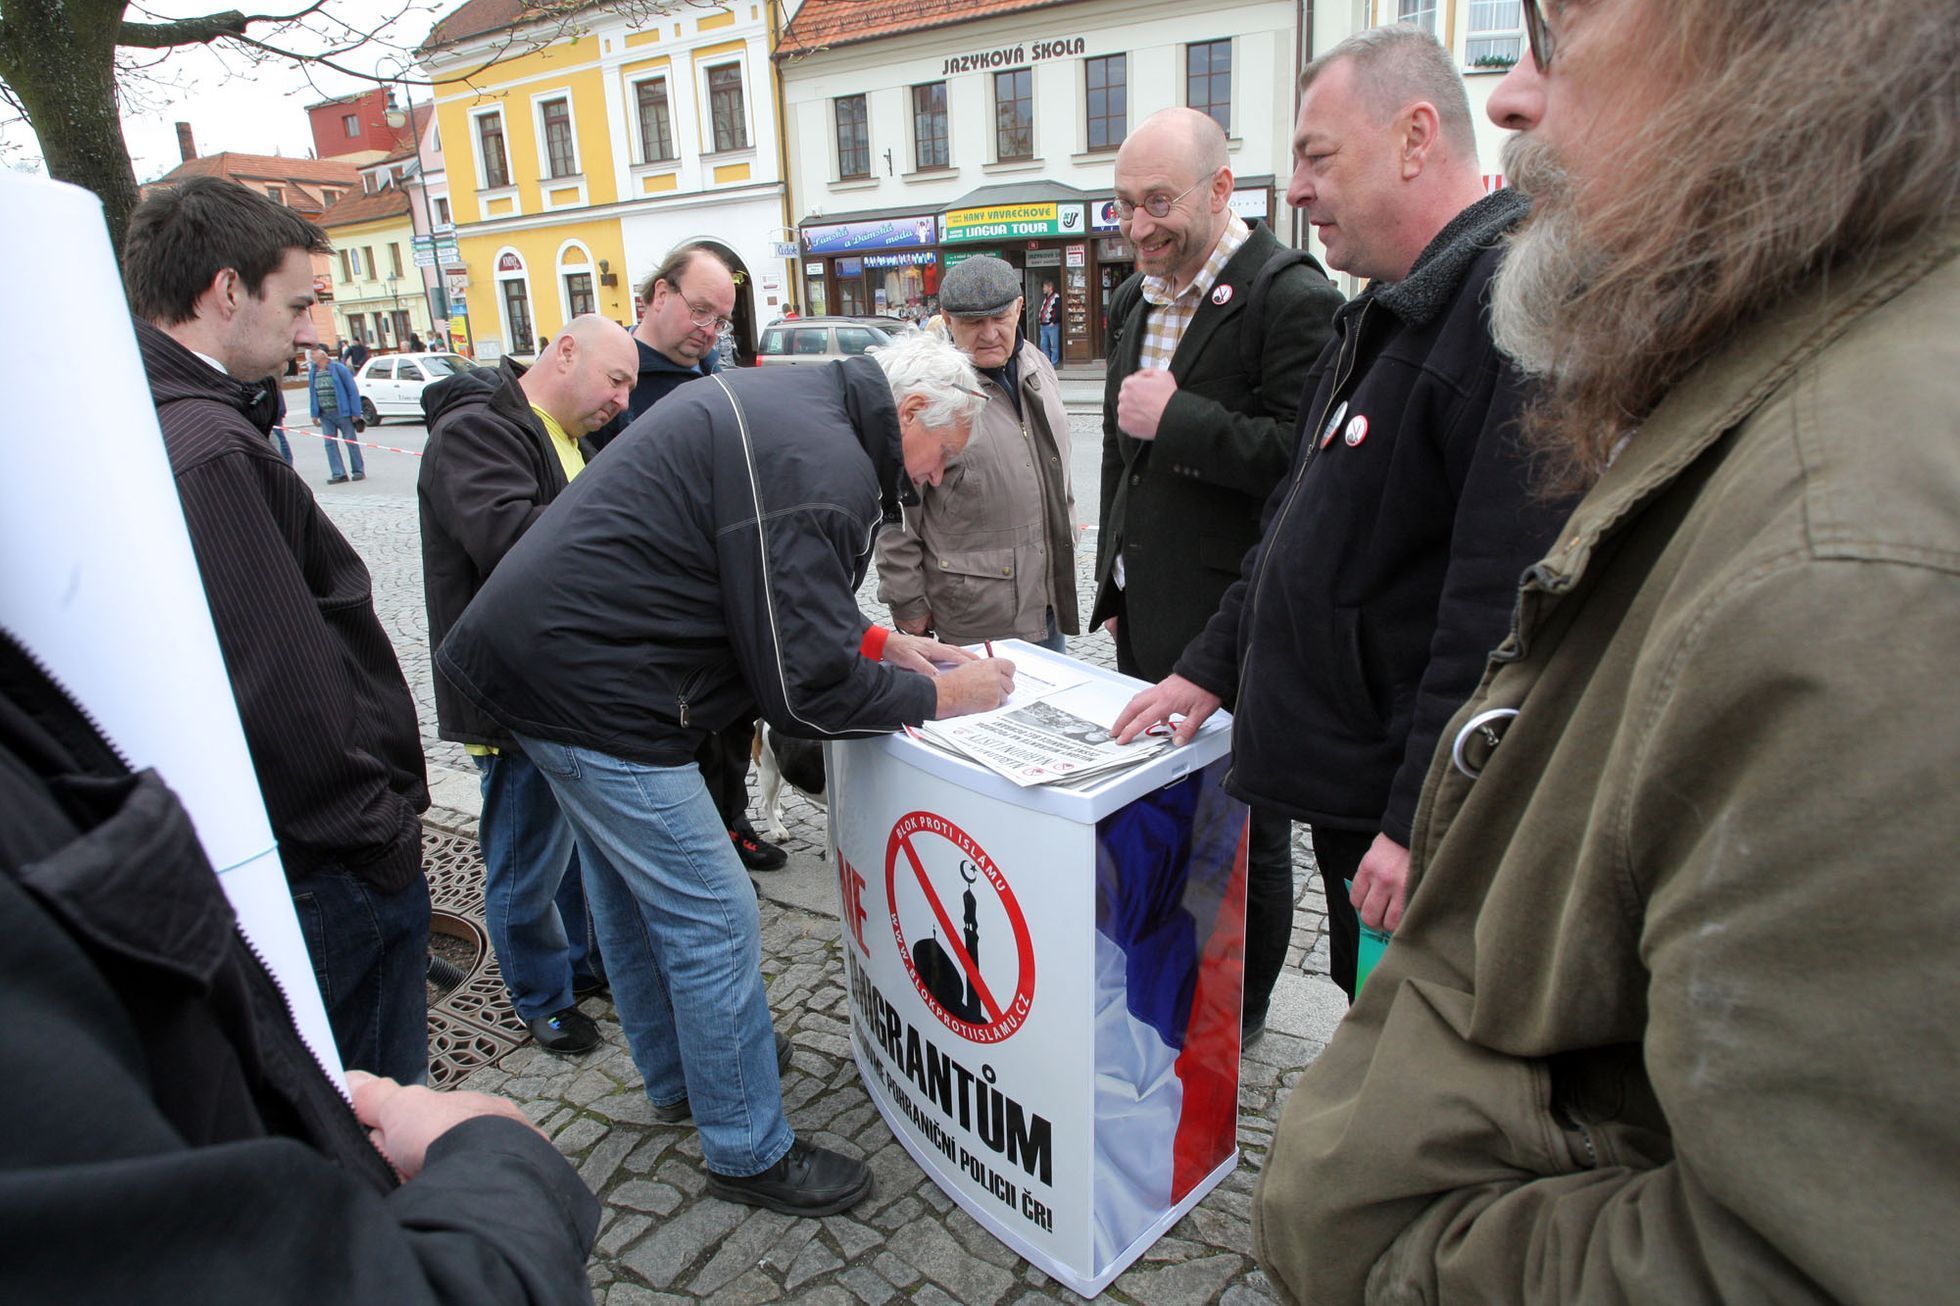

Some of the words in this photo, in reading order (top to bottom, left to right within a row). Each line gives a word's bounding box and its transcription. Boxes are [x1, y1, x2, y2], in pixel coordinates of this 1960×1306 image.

[942, 43, 1025, 75] JAZYKOVÁ
[1031, 37, 1085, 61] ŠKOLA
[966, 225, 1008, 238] LINGUA
[1010, 222, 1048, 234] TOUR
[896, 816, 918, 839] BLOK
[919, 815, 954, 838] PROTI
[956, 833, 1006, 892] ISLÁMU
[886, 1069, 957, 1165] POHRANIČNÍ
[960, 1145, 1017, 1211] POLICII
[1022, 1187, 1054, 1235] ČR!
